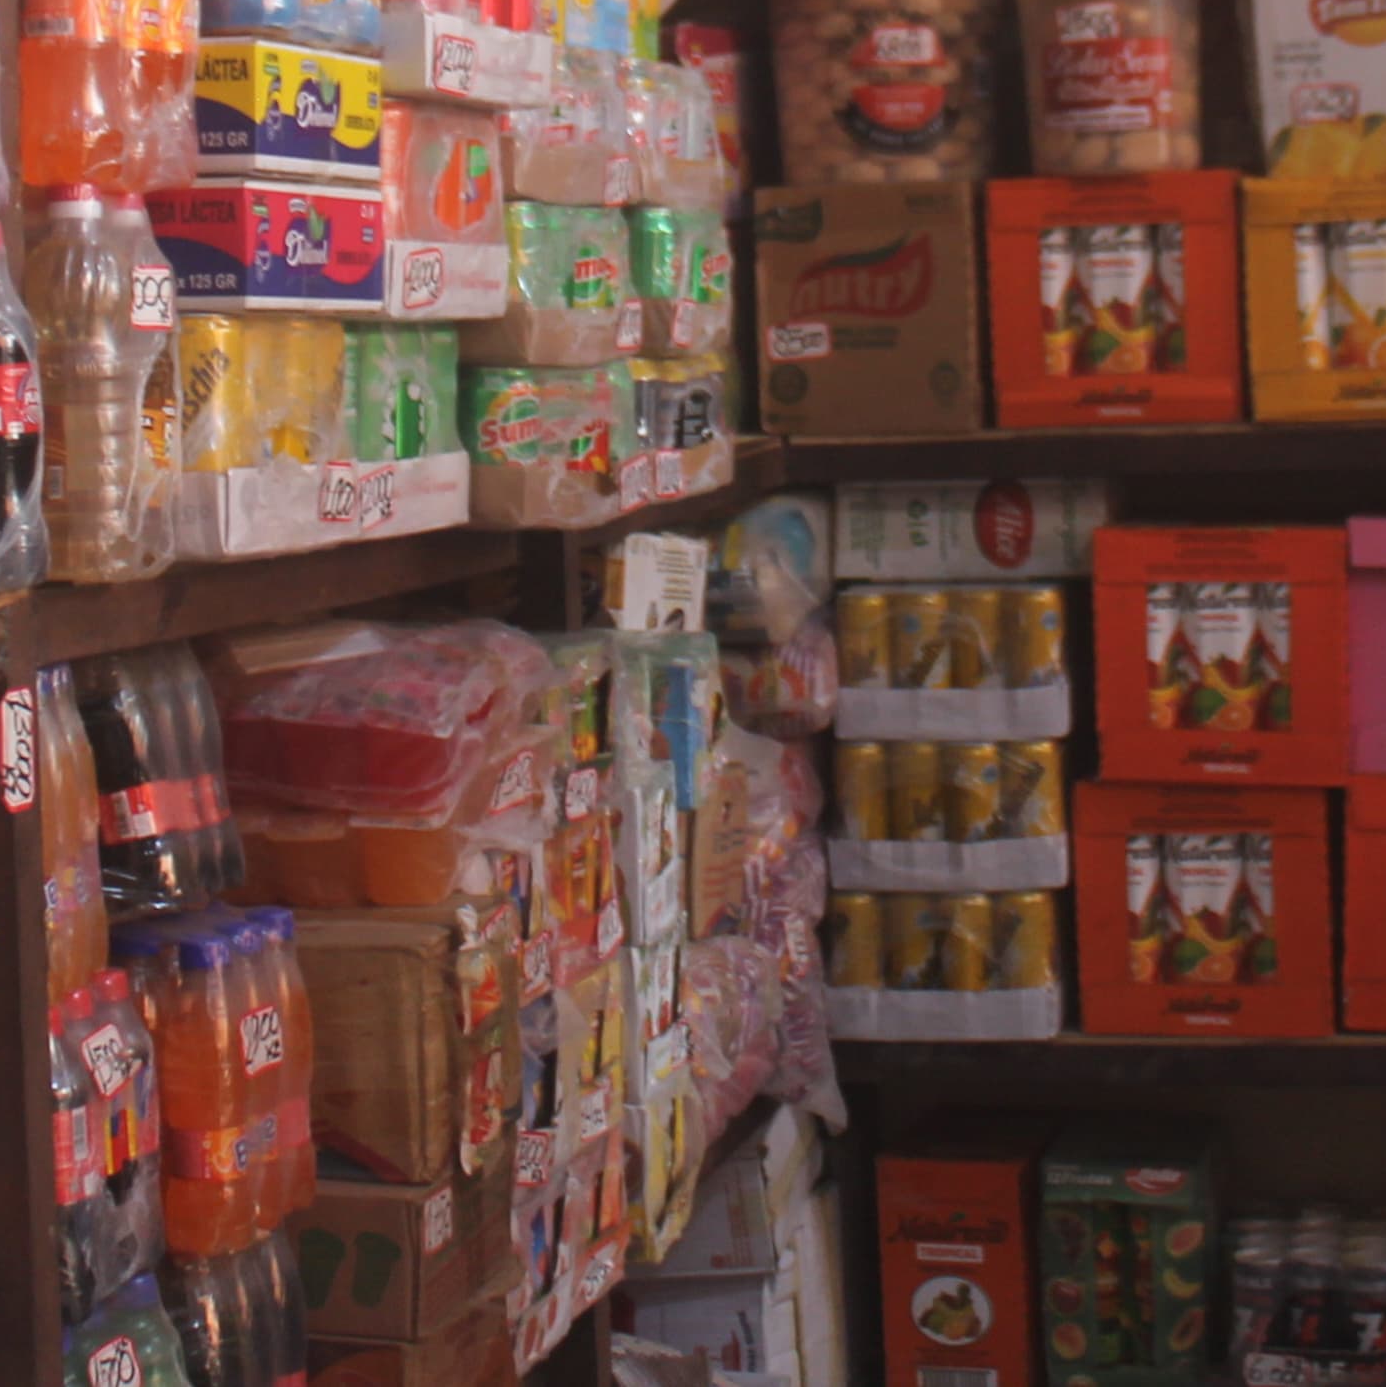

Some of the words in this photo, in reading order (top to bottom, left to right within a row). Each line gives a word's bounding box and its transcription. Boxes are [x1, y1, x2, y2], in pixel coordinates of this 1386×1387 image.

[226, 132, 249, 150] GR
[189, 272, 214, 291] 125
[215, 273, 238, 291] GR
